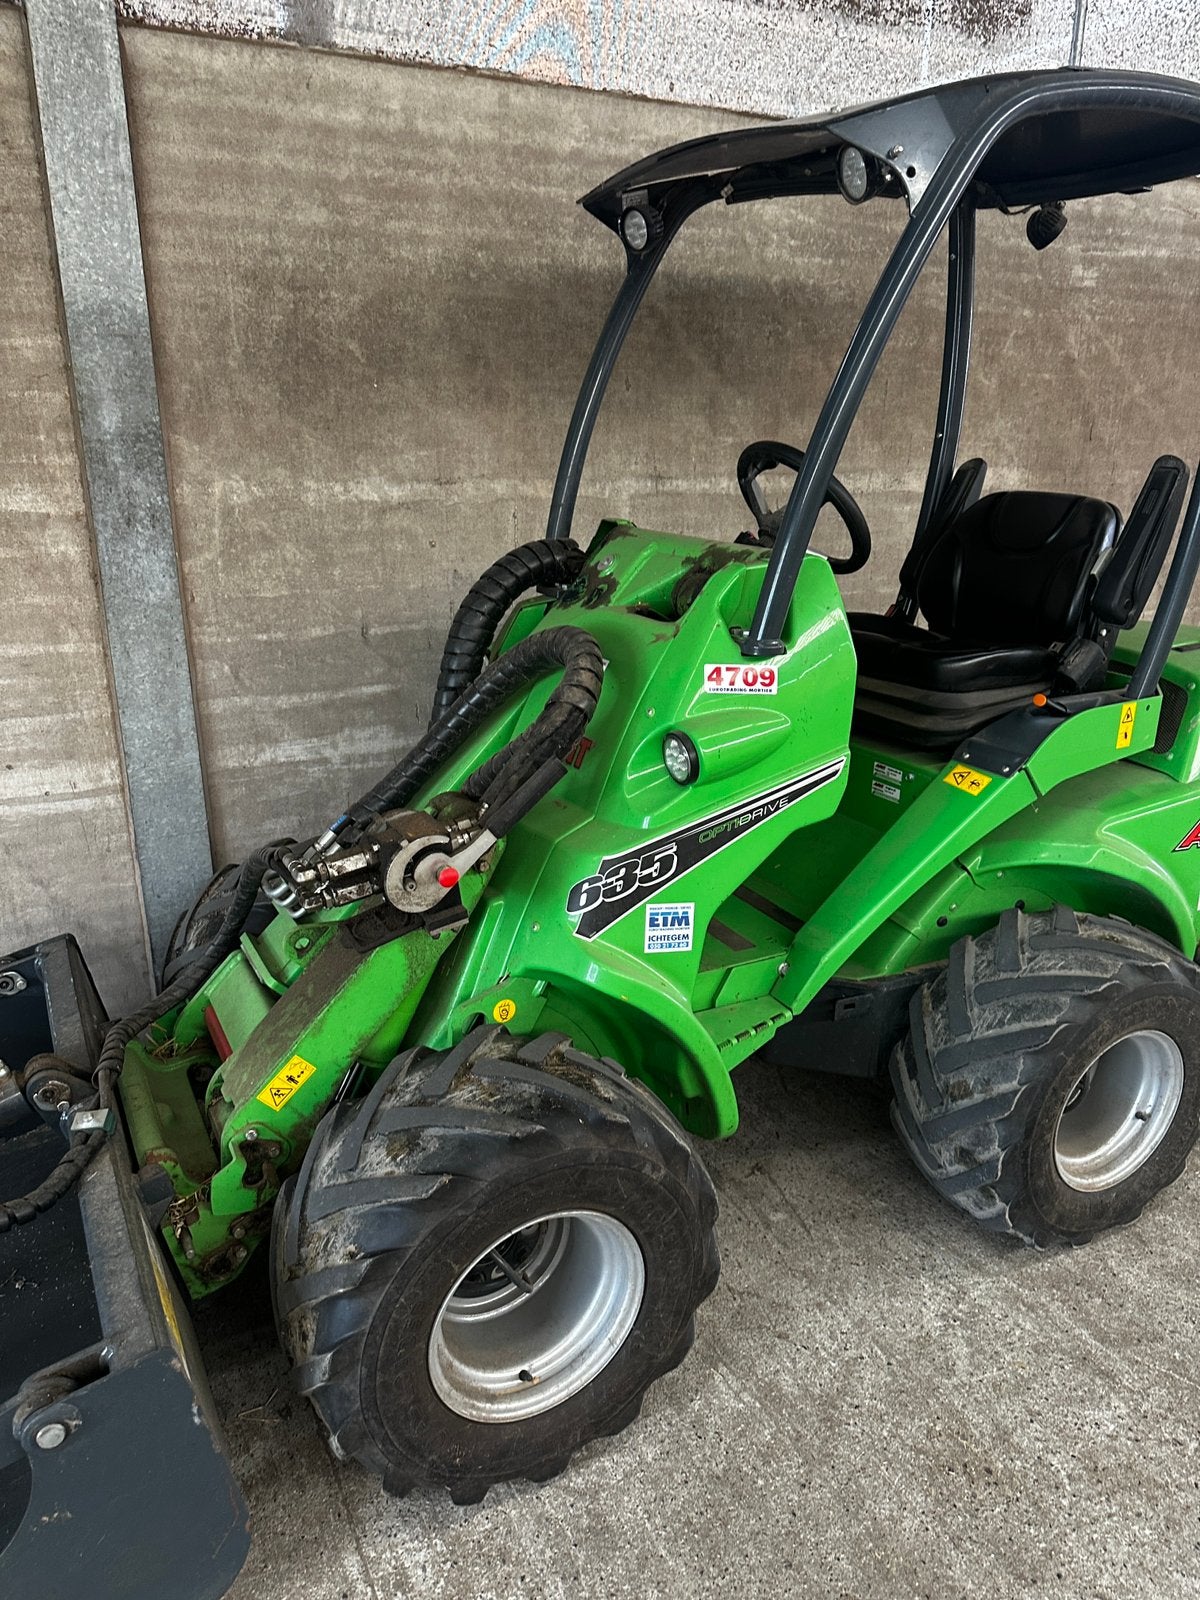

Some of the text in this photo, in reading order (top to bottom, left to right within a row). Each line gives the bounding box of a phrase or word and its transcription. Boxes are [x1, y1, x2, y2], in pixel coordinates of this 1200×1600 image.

[707, 666, 775, 687] 4709
[698, 796, 789, 843] OPTIDRIVE
[566, 842, 678, 914] 635
[649, 911, 690, 927] ETM
[648, 933, 689, 942] ICHTEGEM
